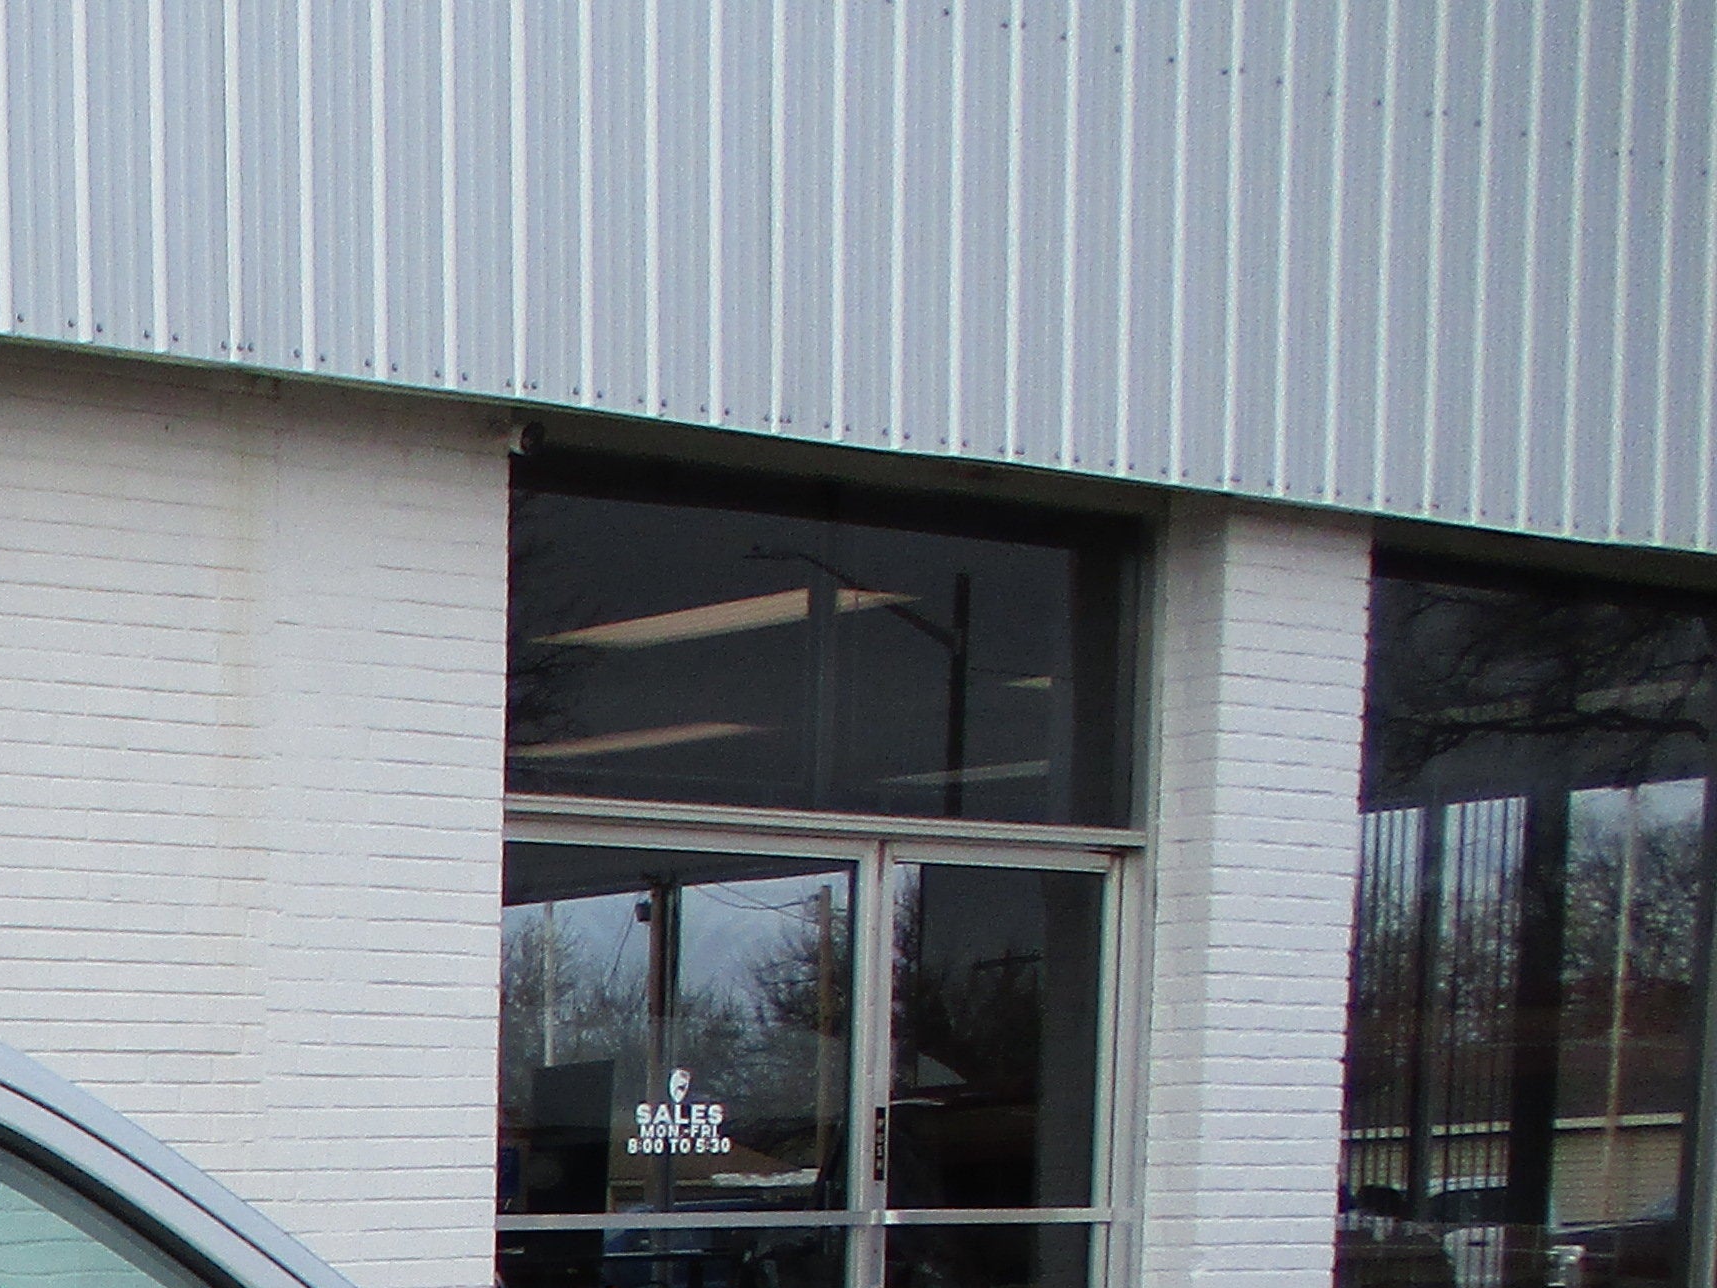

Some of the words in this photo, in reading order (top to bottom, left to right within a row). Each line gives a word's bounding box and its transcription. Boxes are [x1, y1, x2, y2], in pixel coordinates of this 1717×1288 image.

[635, 1103, 723, 1125] SALES
[627, 1137, 664, 1154] 8:00
[668, 1138, 691, 1154] TO
[695, 1137, 731, 1154] 5:30
